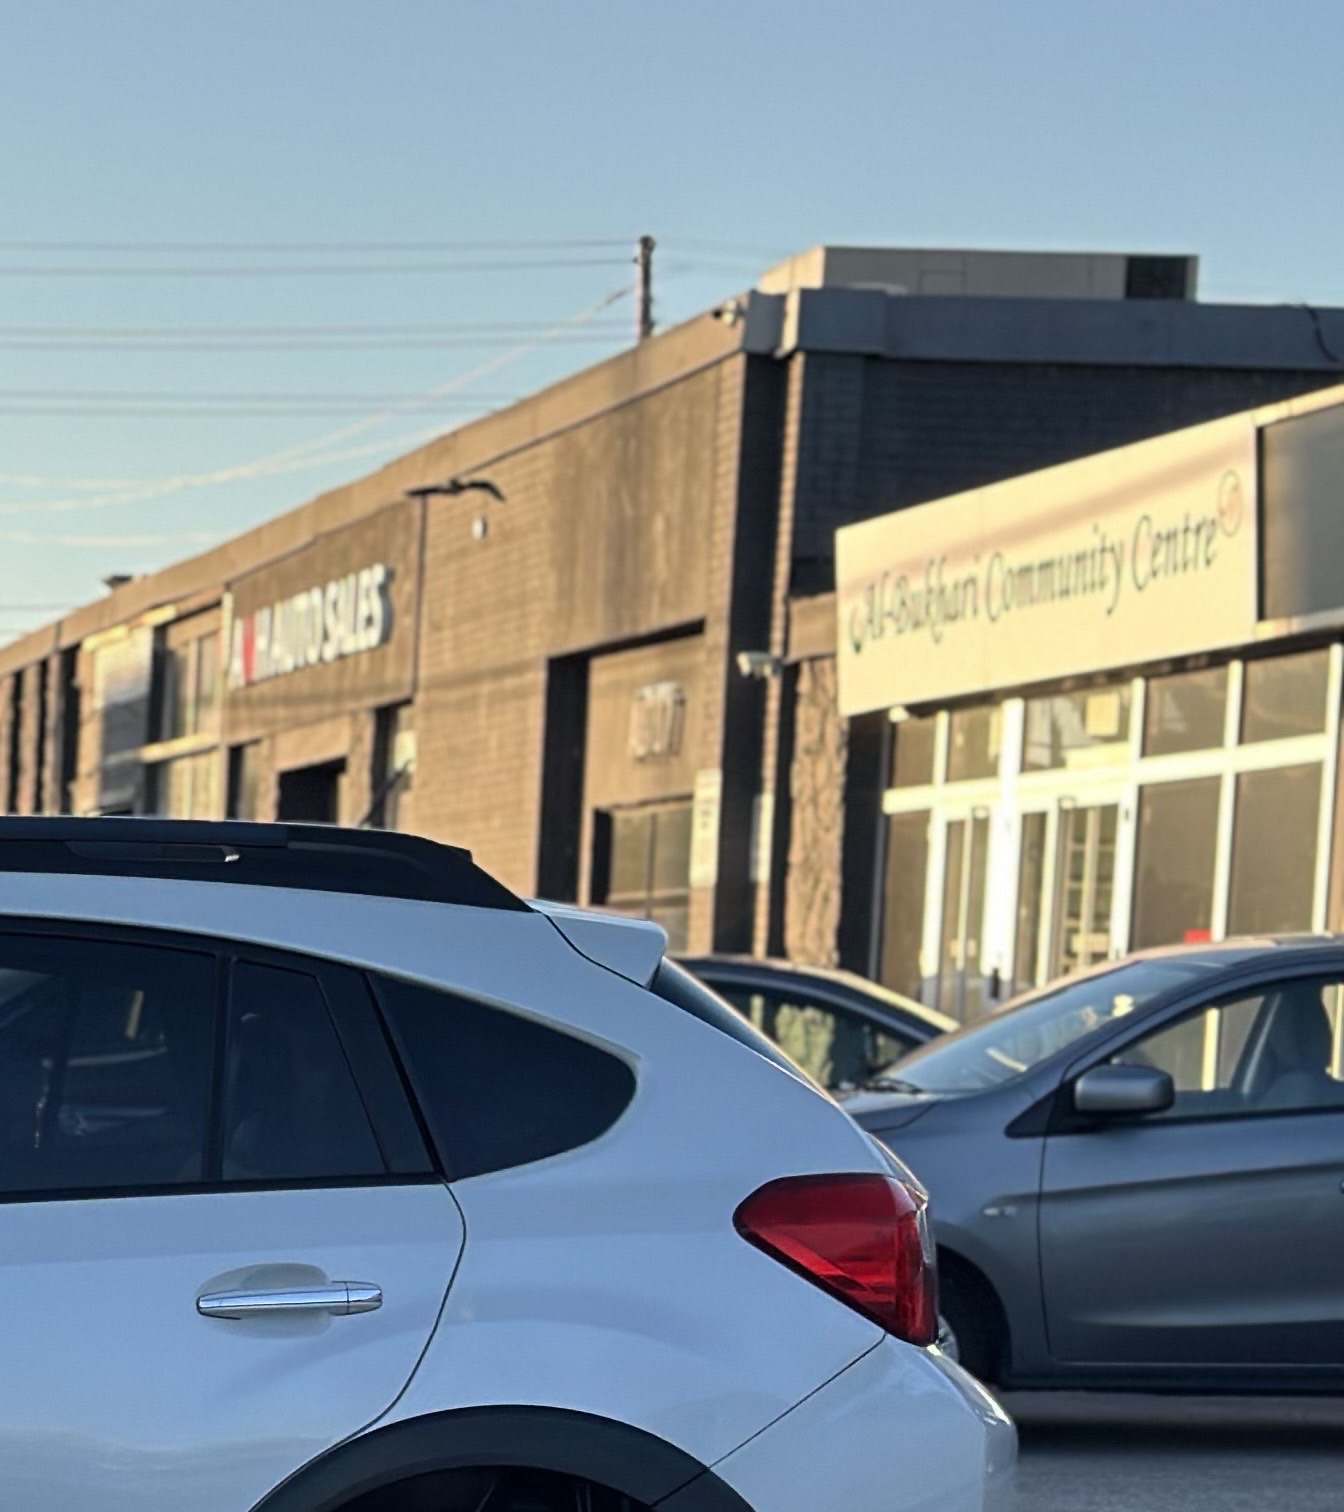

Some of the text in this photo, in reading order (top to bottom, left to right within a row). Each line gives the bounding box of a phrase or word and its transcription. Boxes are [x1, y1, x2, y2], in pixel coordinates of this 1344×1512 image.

[321, 563, 391, 663] SALES
[986, 522, 1125, 621] Community
[1132, 513, 1218, 591] Centre
